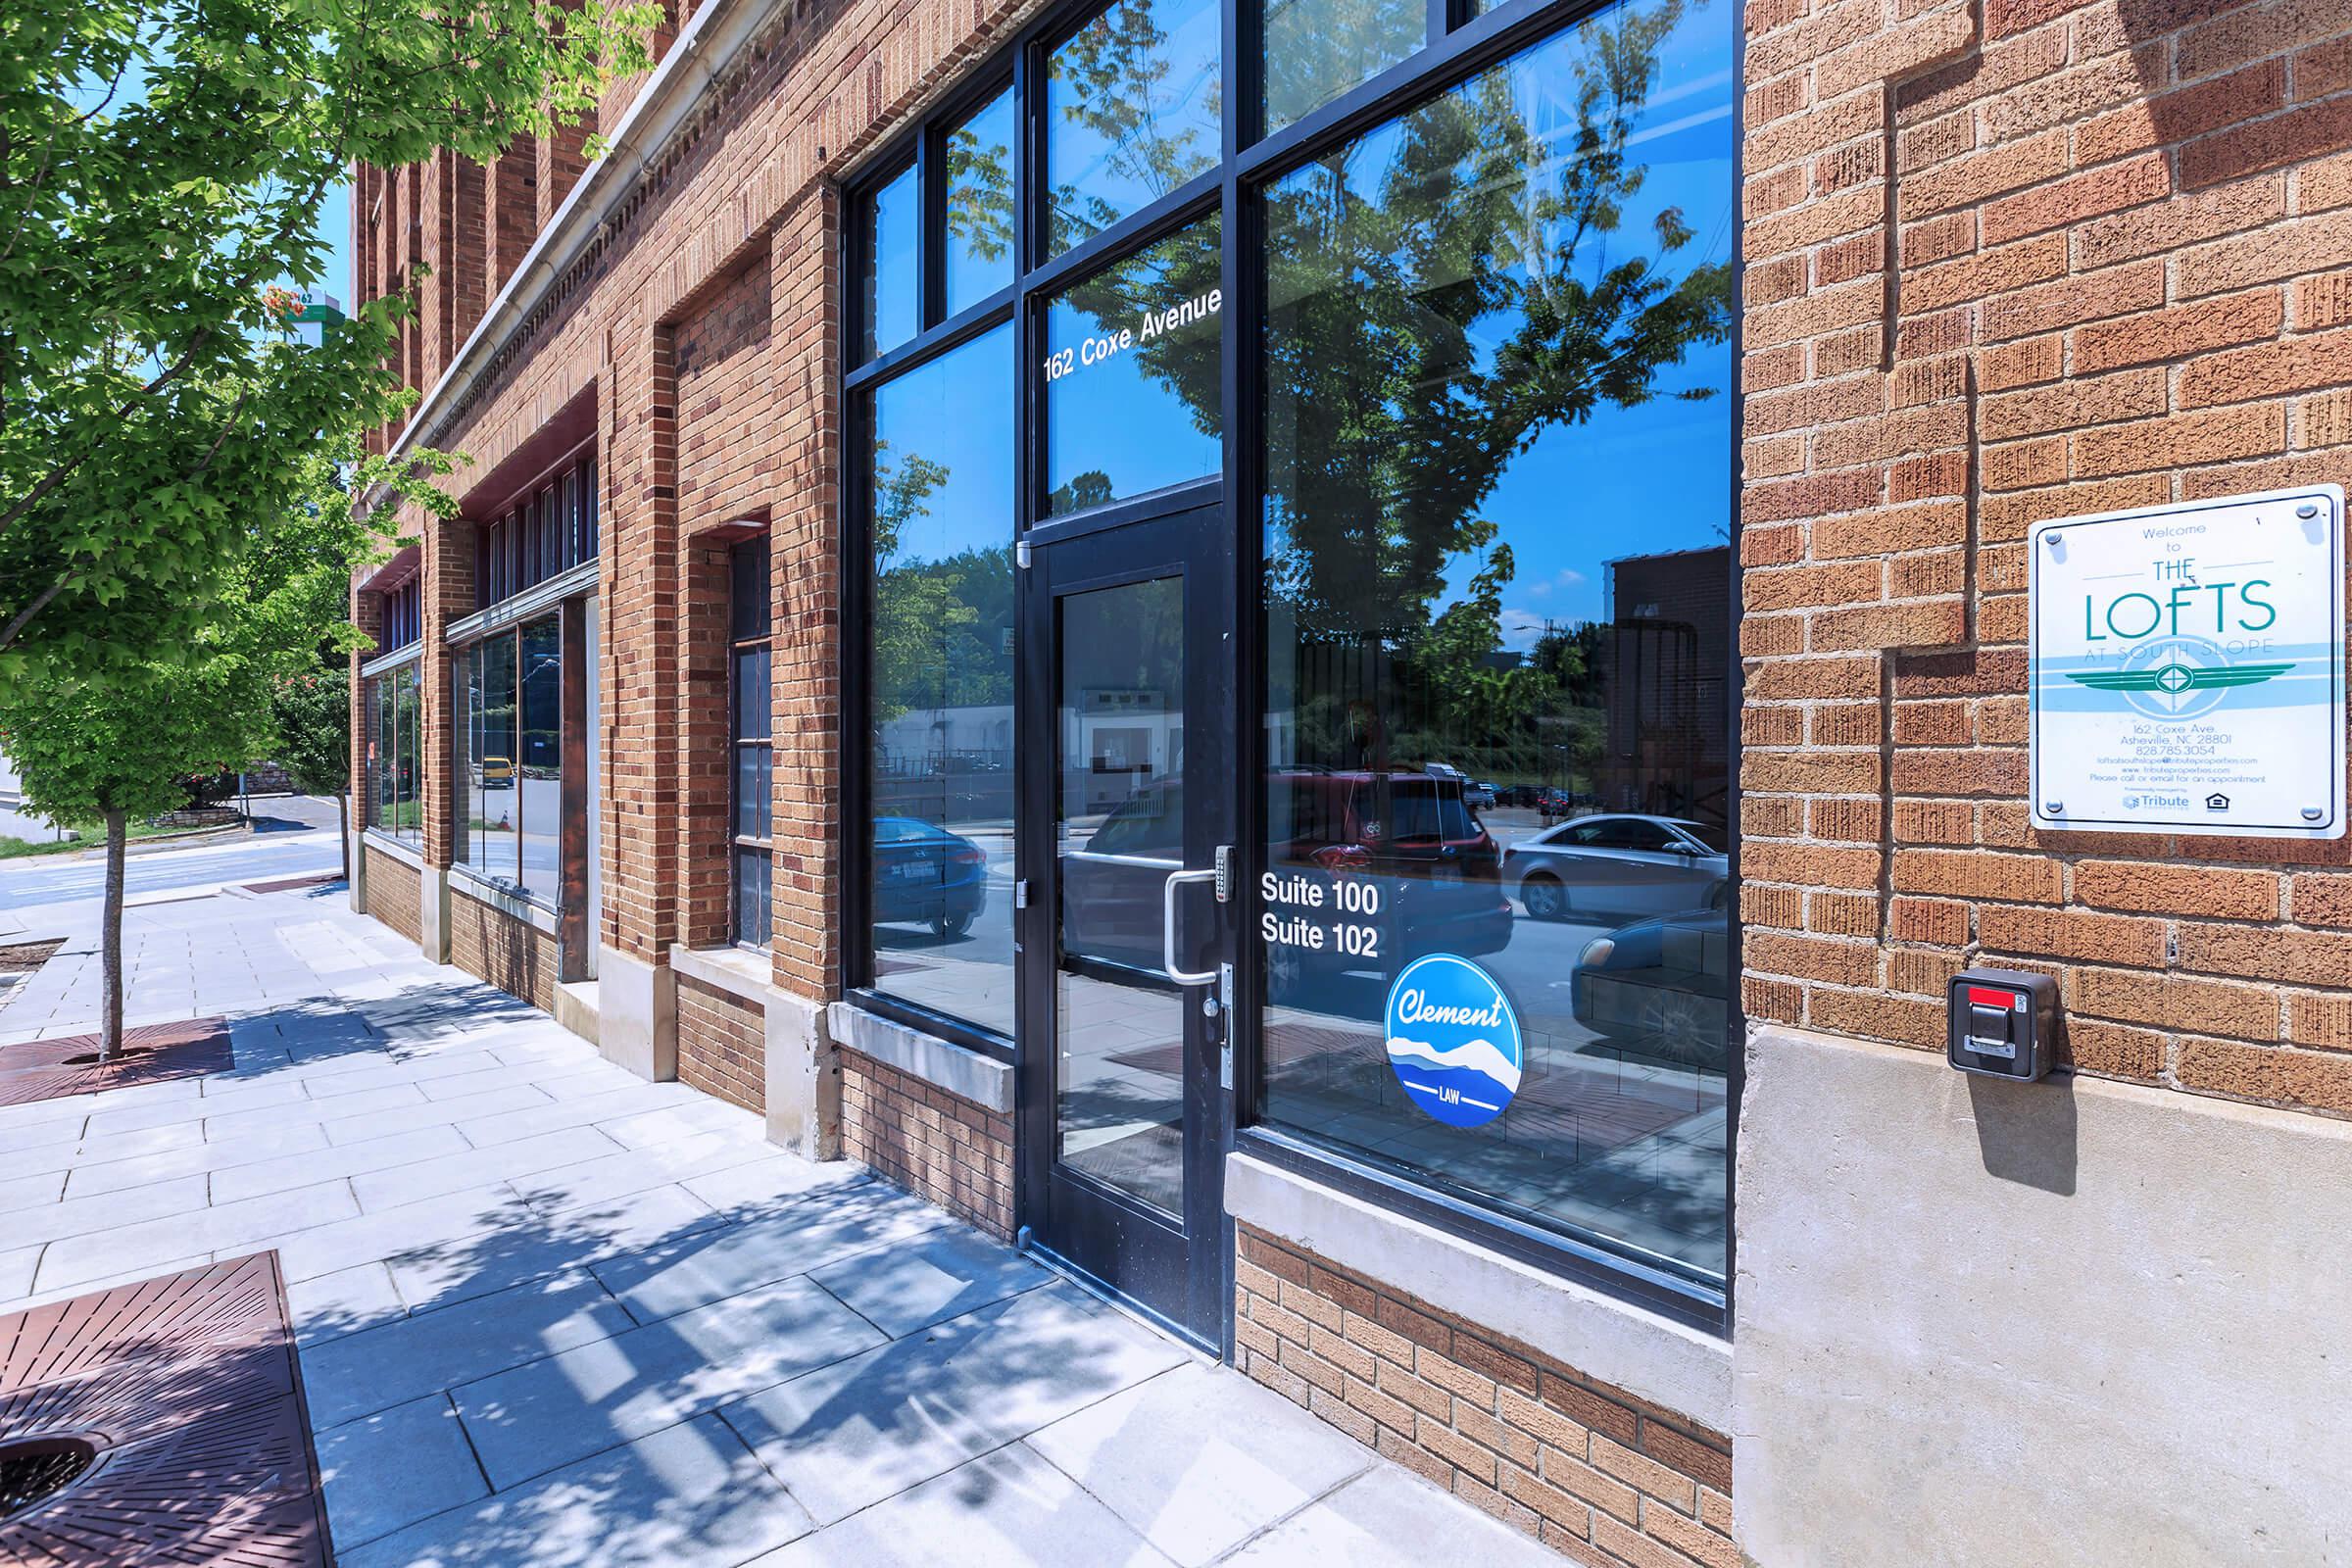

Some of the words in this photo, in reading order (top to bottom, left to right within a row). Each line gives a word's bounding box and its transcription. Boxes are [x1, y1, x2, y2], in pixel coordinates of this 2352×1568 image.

[1044, 348, 1074, 382] 162
[1081, 328, 1132, 366] Coxe
[1140, 289, 1222, 342] Avenue
[2142, 524, 2207, 540] Welcome
[2166, 542, 2181, 553] to
[2152, 558, 2196, 581] THE
[2086, 580, 2277, 641] LOFTS
[2084, 647, 2107, 662] AT
[2118, 643, 2189, 661] SOUTH
[2202, 639, 2275, 657] SLOPE
[2121, 735, 2173, 745] Asheville,
[2176, 735, 2192, 745] NC
[2196, 734, 2231, 745] 28801
[2133, 724, 2151, 734] 162
[2156, 724, 2186, 734] Coxe
[2135, 745, 2215, 756] 828.785.3054
[2140, 795, 2189, 807] Tribute
[1261, 872, 1324, 907] Suite
[1332, 880, 1379, 915] 100
[1261, 912, 1324, 950] Suite
[1332, 923, 1379, 958] 102
[1397, 989, 1502, 1028] Clement
[1439, 1085, 1460, 1105] LAW
